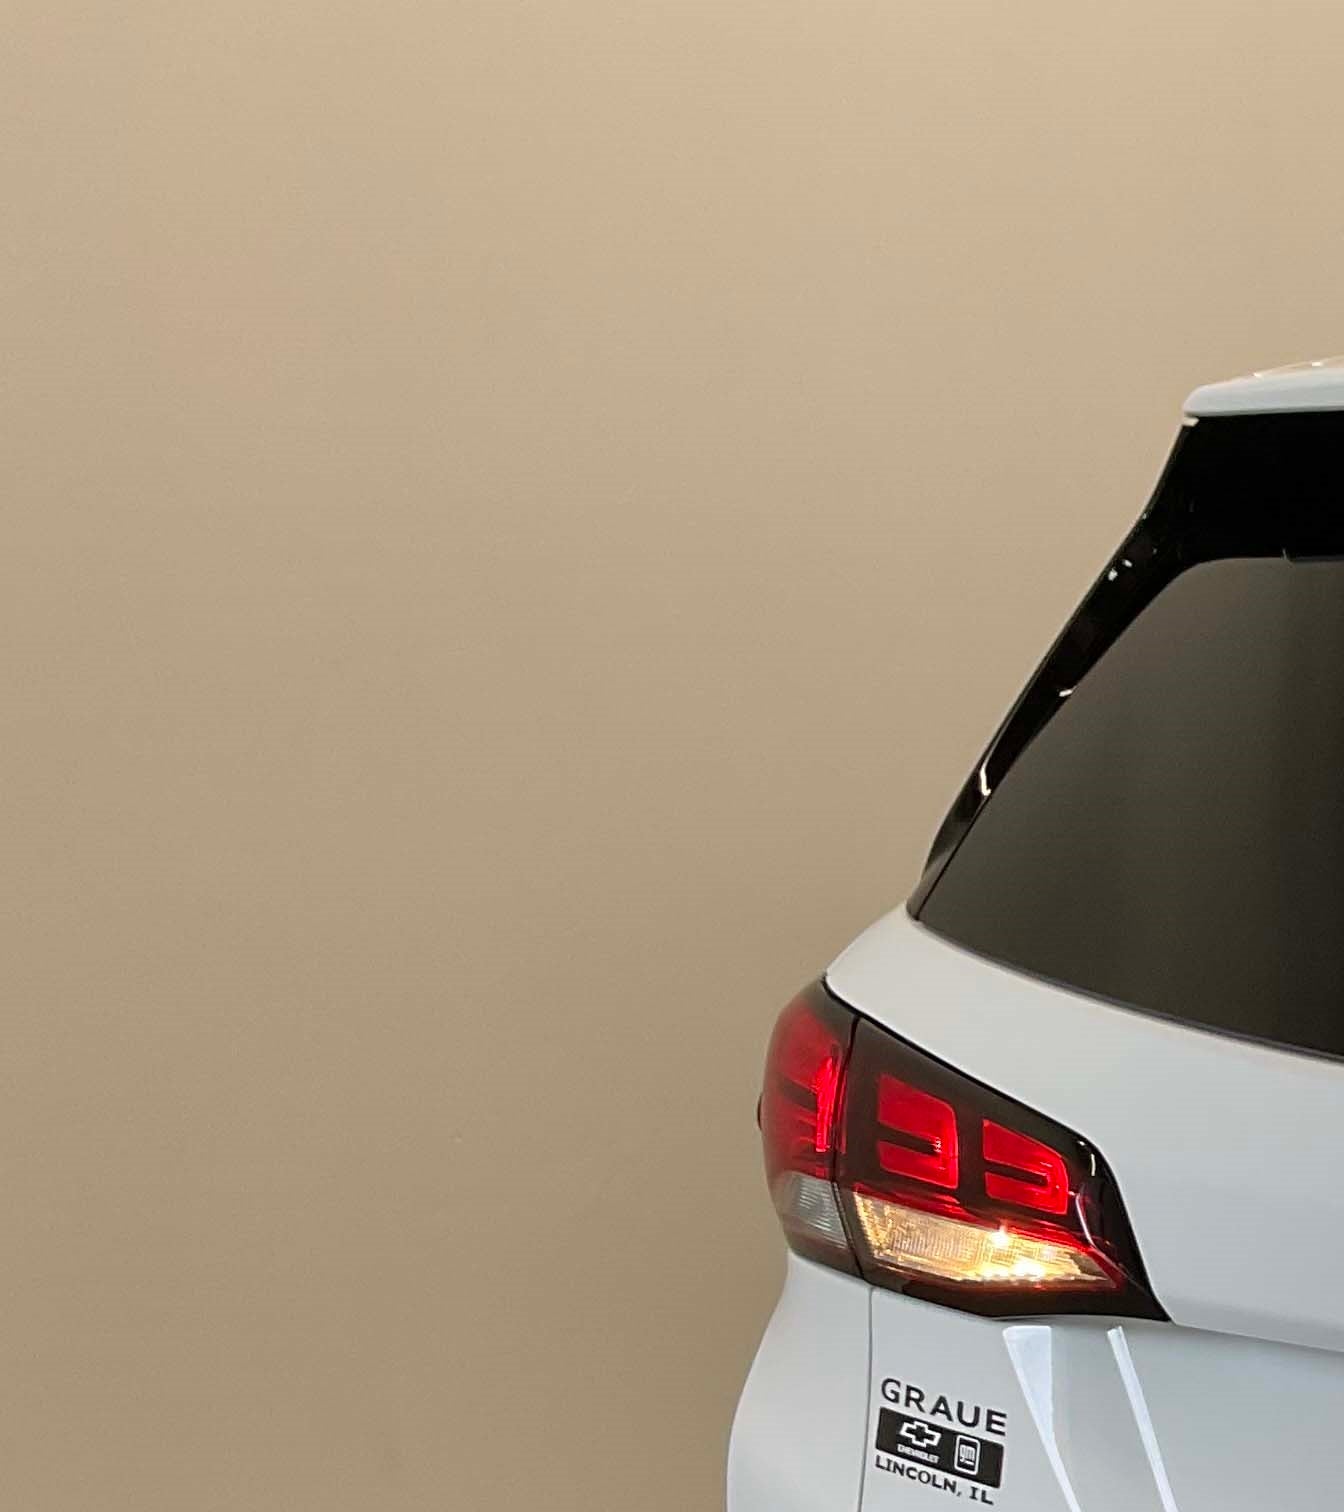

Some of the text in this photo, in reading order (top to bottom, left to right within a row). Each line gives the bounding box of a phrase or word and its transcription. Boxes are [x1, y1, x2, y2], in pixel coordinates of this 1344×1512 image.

[880, 1377, 1008, 1437] GRAUE
[875, 1454, 995, 1506] LINCOLN, IL
